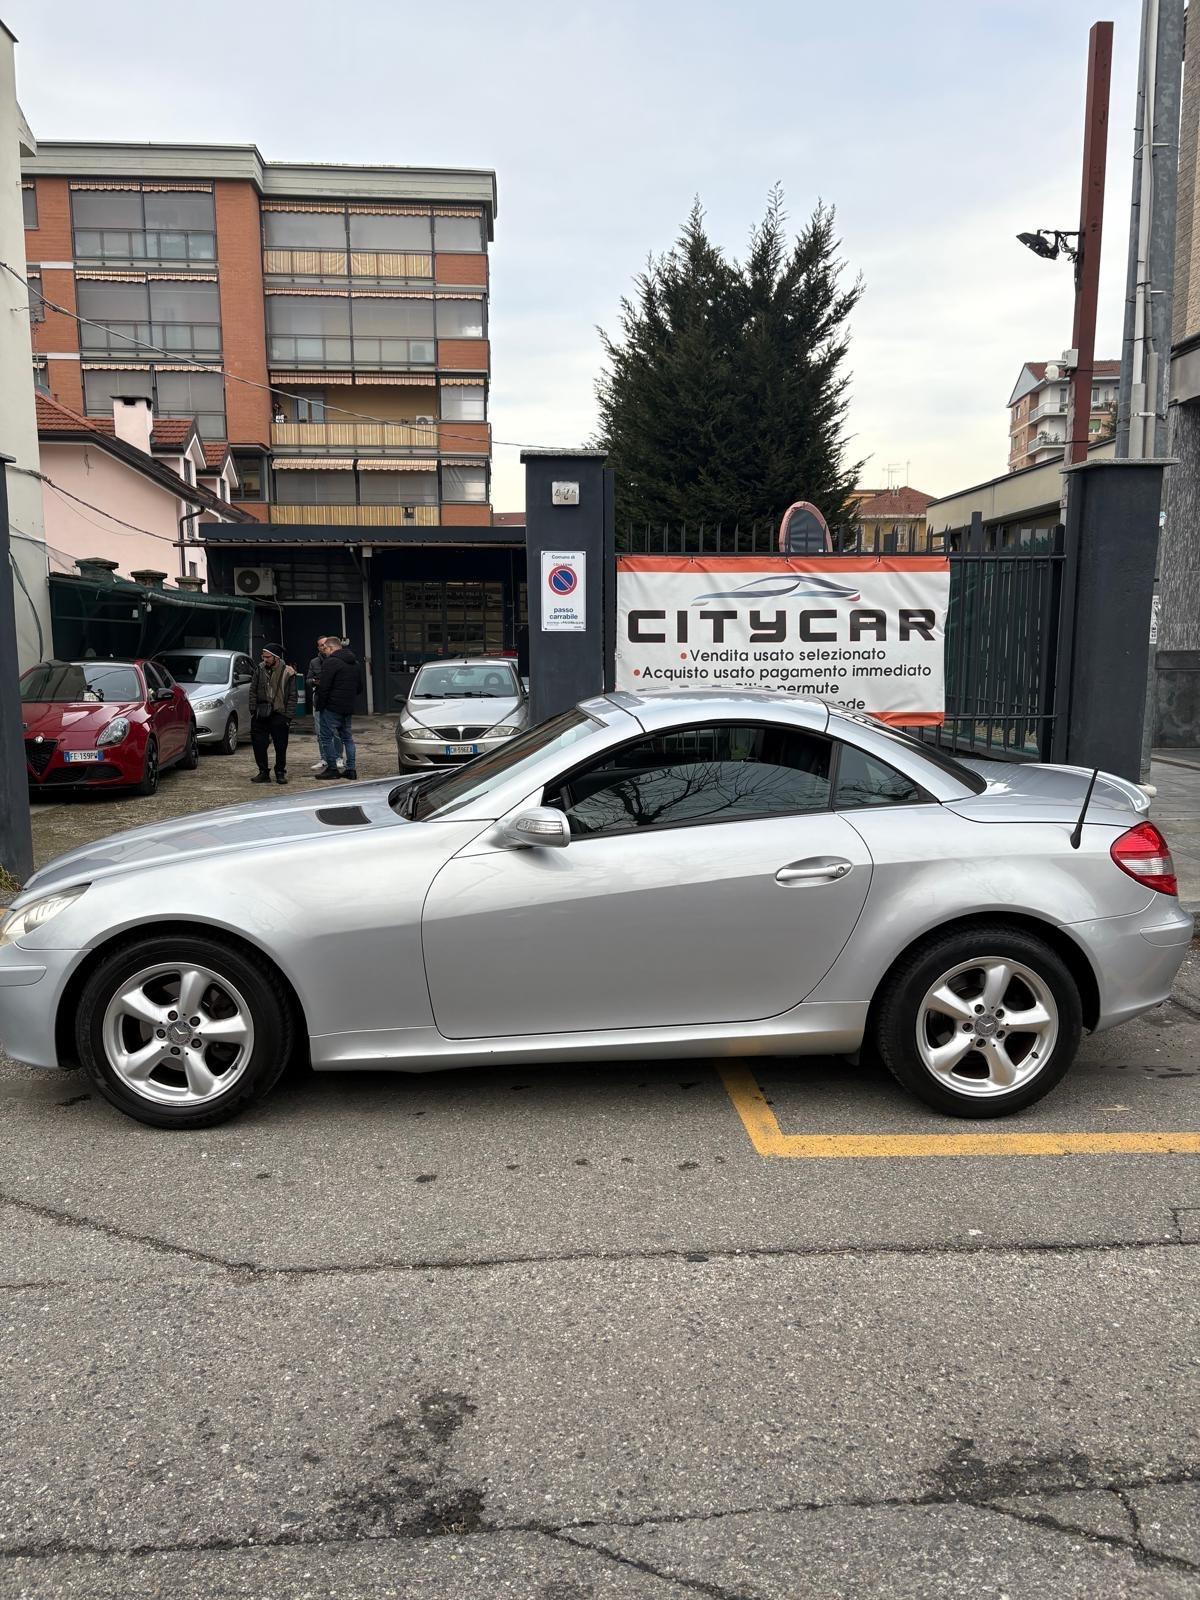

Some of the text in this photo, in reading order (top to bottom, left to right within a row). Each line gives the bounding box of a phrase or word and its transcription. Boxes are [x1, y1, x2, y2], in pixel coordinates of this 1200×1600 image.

[628, 609, 936, 643] CITYCAR
[690, 647, 886, 662] Vendita usato selezionato
[642, 663, 931, 680] Acquisto usato pagamento immediato
